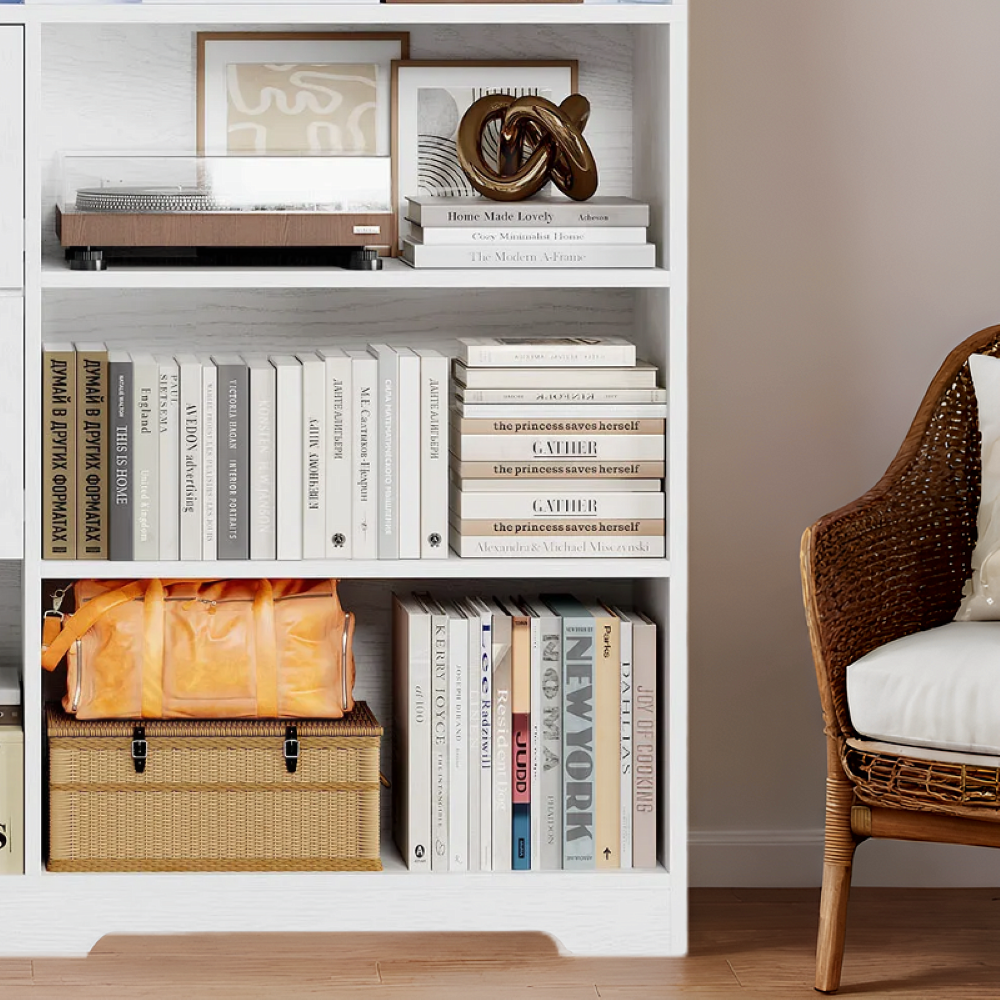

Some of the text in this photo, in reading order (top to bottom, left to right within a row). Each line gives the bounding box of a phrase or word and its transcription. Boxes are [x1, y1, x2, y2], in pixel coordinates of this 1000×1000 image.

[447, 211, 554, 225] Home Made Lovely
[471, 232, 584, 242] Cozy Minimalist Home
[468, 251, 586, 262] The Modern A-Frame
[160, 374, 168, 434] SIETSEMA
[170, 375, 178, 406] PAUL
[50, 359, 72, 542] ДУМАЙ В ДРУГИХ ФОРМАТАХ
[83, 359, 104, 542] ДУМАЙ В ДРУГИХ ФОРМАТАХ
[357, 409, 370, 502] Салтыков-Щедрин
[384, 379, 392, 535] СИЛА МАТЕМАТИЧЕСКОГО МЫШЛЕНИЯ
[493, 422, 513, 430] the
[515, 423, 563, 432] princess
[599, 422, 640, 430] herself
[532, 440, 597, 455] GATHER
[116, 425, 128, 505] THIS IS HOME
[138, 388, 152, 542] England United Kingdom
[182, 403, 197, 514] AVEDON advertising
[229, 379, 237, 540] VICTORIA HAGAN INTERIOR PORTRAITS
[493, 464, 640, 476] the princess saves herself
[493, 522, 640, 534] the princess saves herself
[532, 499, 597, 513] GATHER
[475, 542, 529, 552] Alexandra
[530, 542, 541, 552] &
[543, 542, 586, 552] Michael
[435, 624, 446, 681] KERRY
[602, 624, 612, 658] Parks
[481, 624, 490, 768] Lee Radziwill
[566, 635, 593, 722] NEW
[414, 701, 426, 722] 100
[435, 688, 446, 746] JOYCE
[542, 633, 559, 844] NOMA PHAIDON
[622, 661, 631, 775] DAHLIAS
[494, 689, 508, 811] Resident Dog
[516, 731, 527, 793] JUDD
[636, 684, 654, 812] JOY OF COOKING
[566, 726, 593, 842] YORK
